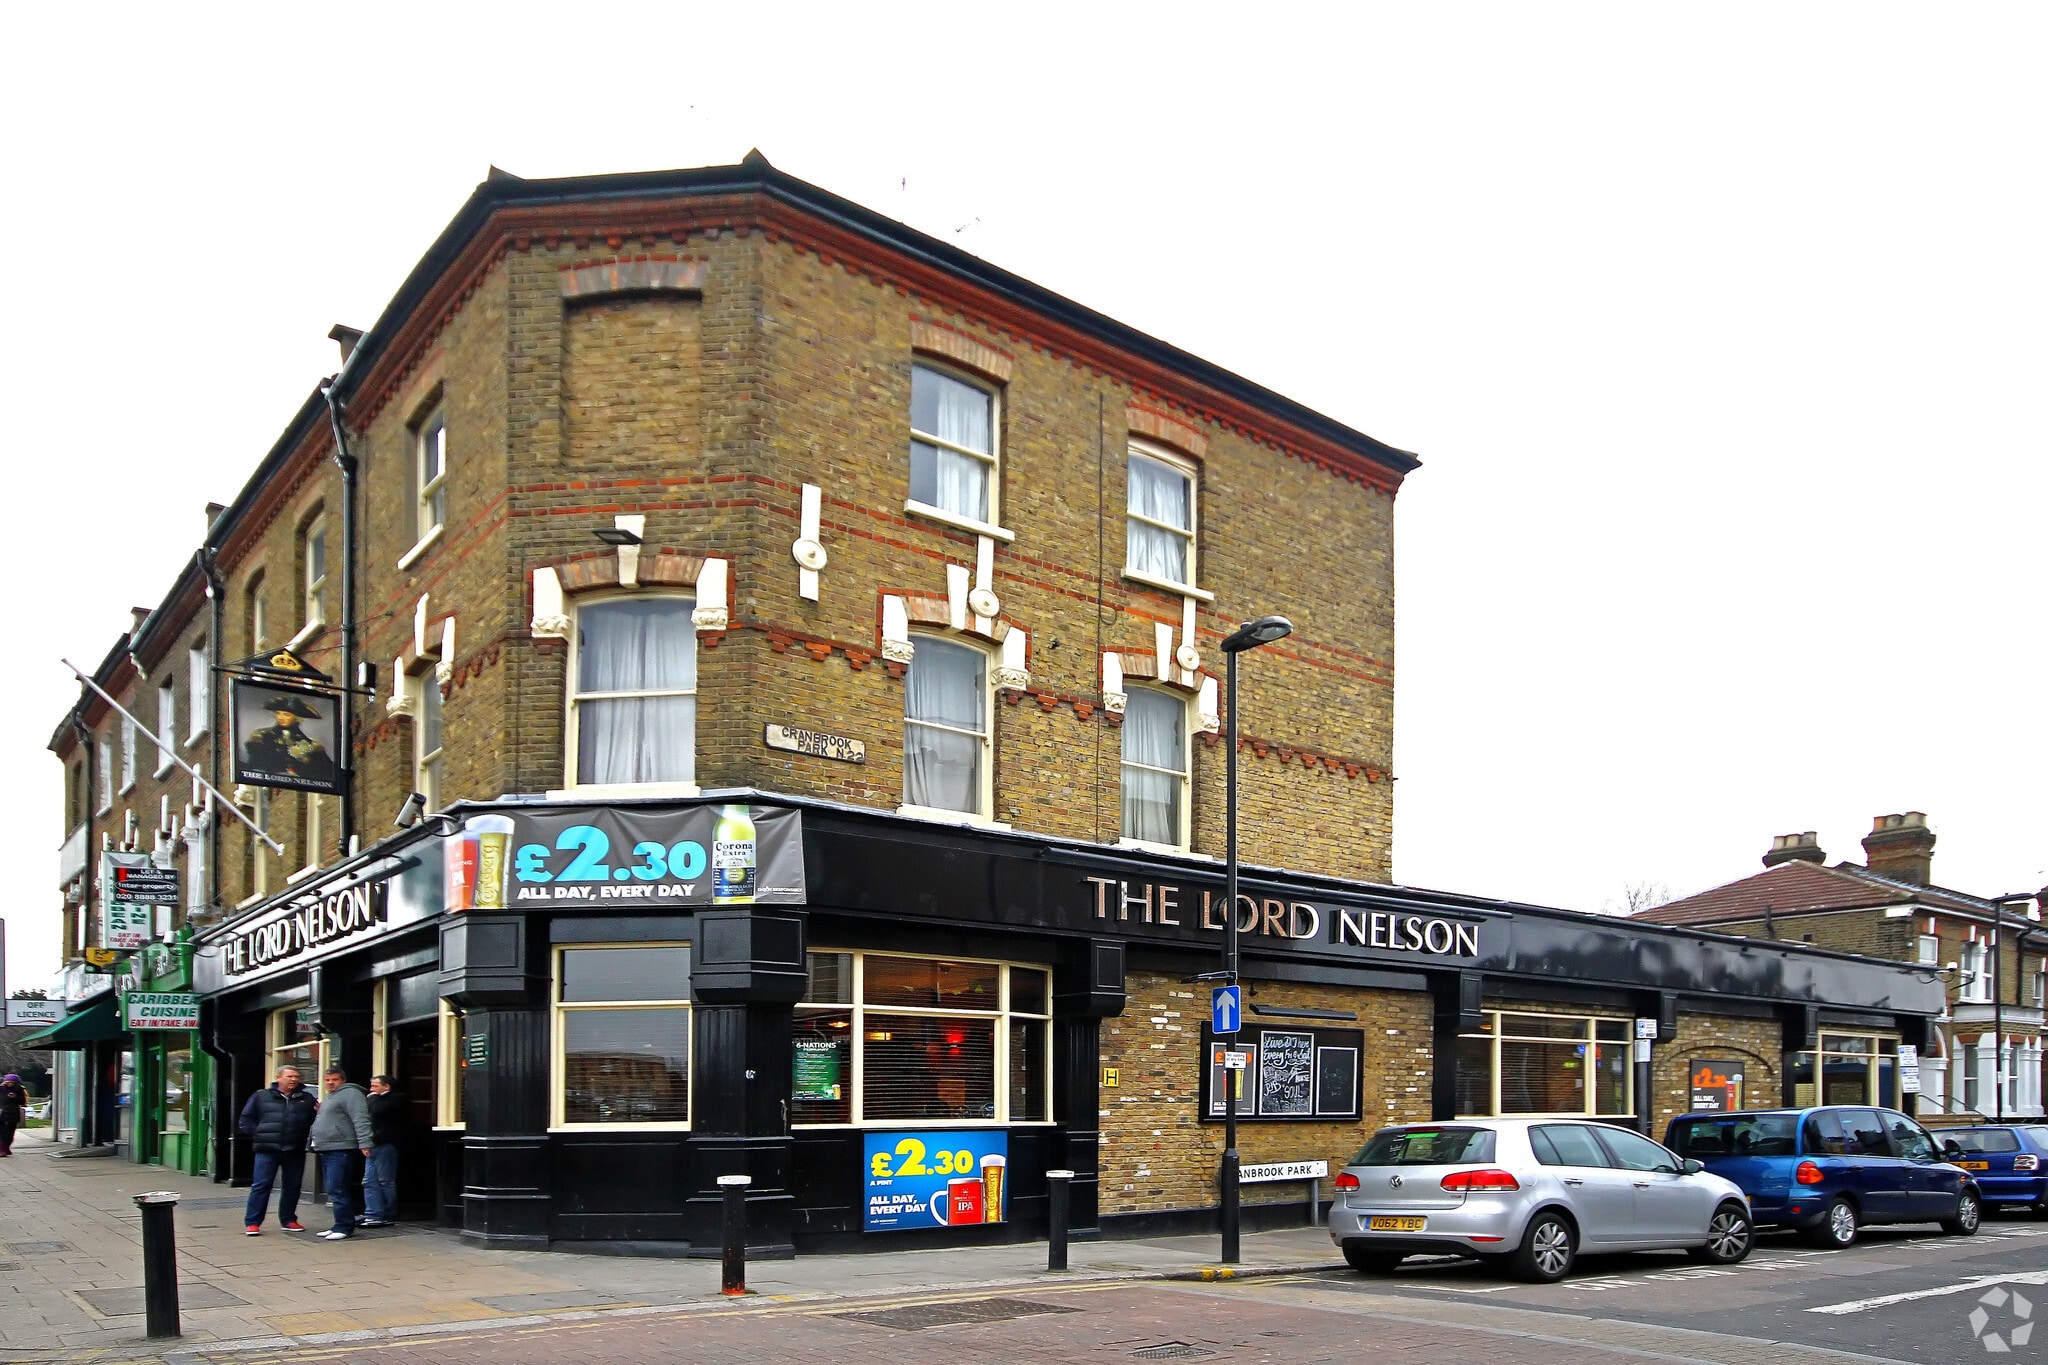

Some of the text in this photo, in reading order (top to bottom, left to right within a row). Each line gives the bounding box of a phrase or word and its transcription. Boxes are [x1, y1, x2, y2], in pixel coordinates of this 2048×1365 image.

[781, 727, 852, 750] CRANBROOK
[797, 740, 828, 756] PARK
[241, 770, 334, 788] THE LORD NELSON
[514, 825, 707, 882] £2.30
[715, 842, 753, 852] Corona
[516, 883, 695, 901] ALL DAY, EVERY DAY
[1087, 876, 1479, 957] THE LORD NELSON
[220, 937, 245, 976] THE
[248, 918, 292, 967] LORD
[295, 881, 371, 949] NELSON
[27, 1001, 45, 1009] OFF
[129, 994, 197, 1004] CARIBBEA
[140, 1006, 197, 1017] CUISINE
[130, 1019, 147, 1027] EAT
[1106, 1069, 1117, 1085] H
[870, 1138, 974, 1178] £2.30
[1238, 1167, 1284, 1179] ANBROOK
[1287, 1165, 1312, 1175] PARK
[869, 1194, 917, 1205] ALL DAY,
[958, 1201, 973, 1211] IPA
[870, 1203, 927, 1215] EVERY DAY
[1372, 1218, 1422, 1229] VO62 YBC
